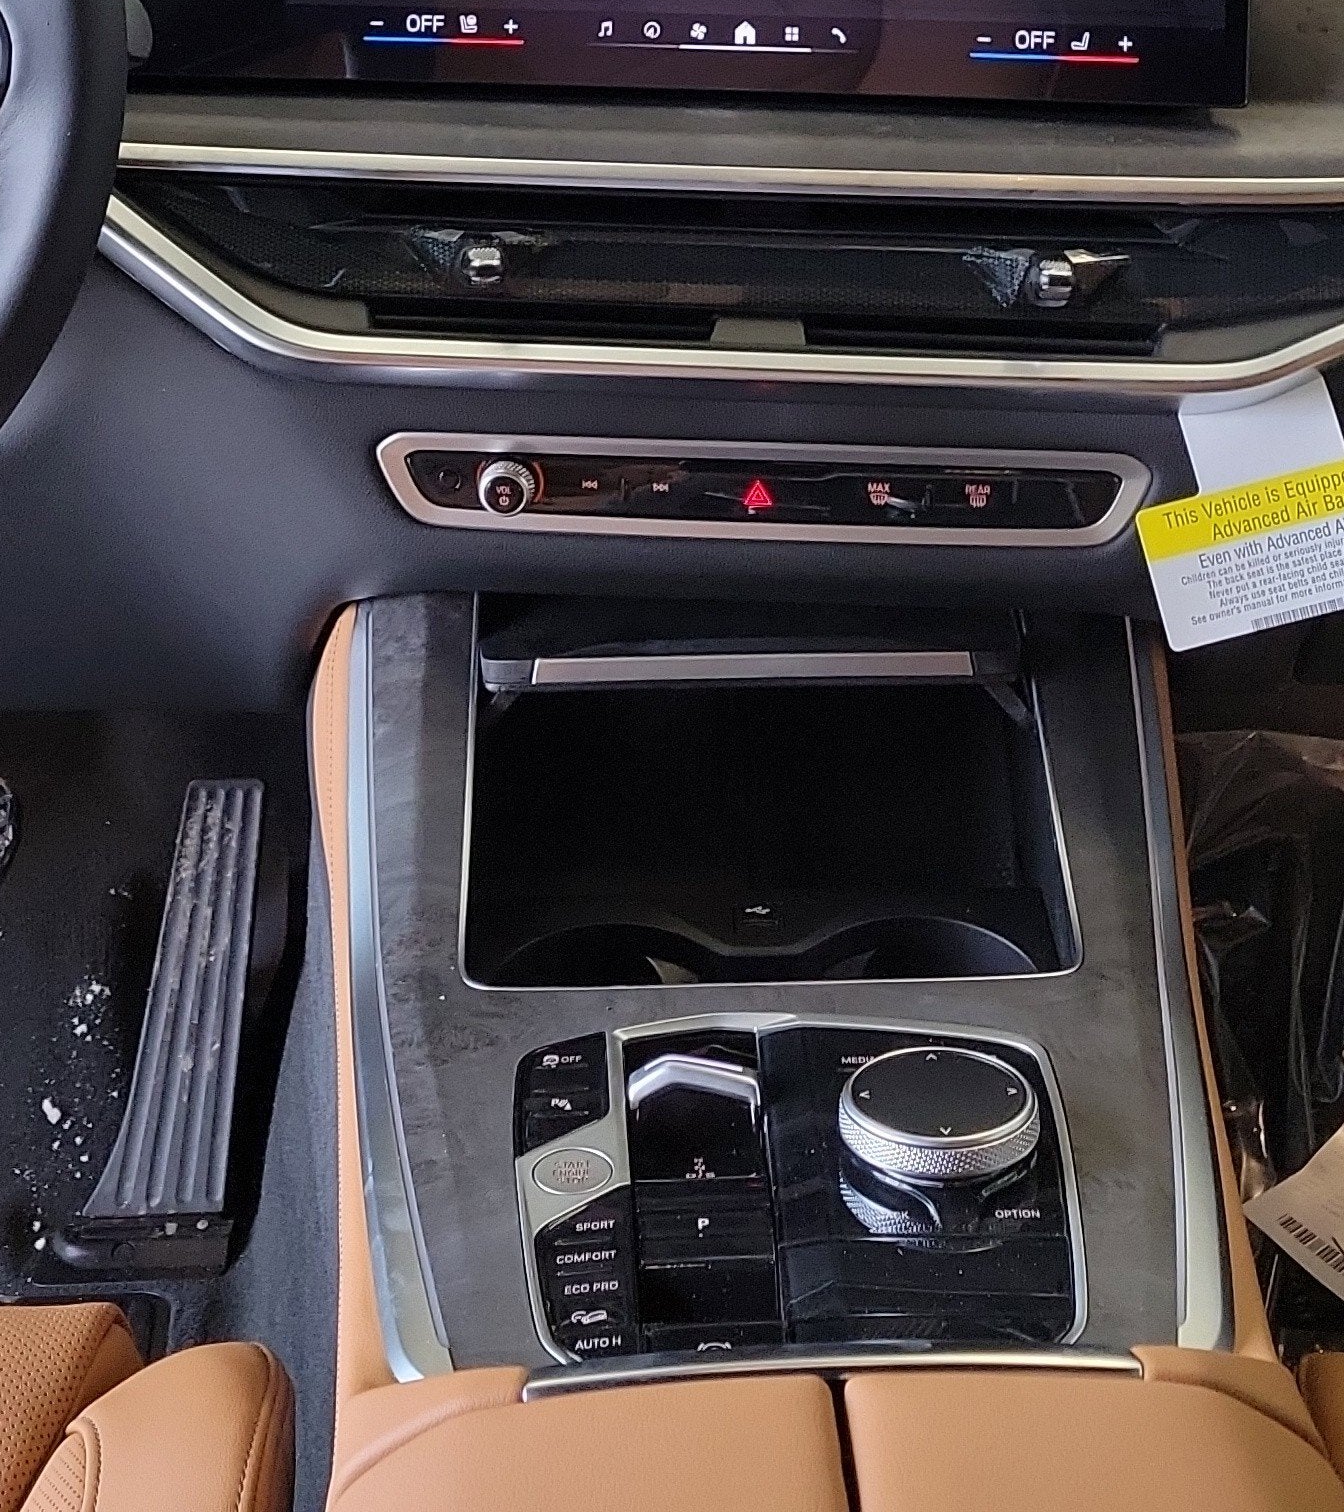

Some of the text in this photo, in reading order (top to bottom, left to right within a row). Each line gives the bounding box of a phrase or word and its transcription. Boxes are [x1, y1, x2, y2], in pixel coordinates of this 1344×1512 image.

[405, 13, 446, 33] OFF
[1014, 29, 1056, 50] OFF
[496, 485, 512, 495] VOL
[867, 482, 891, 493] MAX
[1162, 505, 1198, 529] This
[1201, 489, 1261, 520] Vehicle
[1264, 484, 1280, 503] is
[1209, 505, 1290, 540] Advanced
[1293, 497, 1319, 518] Air
[1198, 547, 1231, 568] Even
[1232, 538, 1263, 560] with
[1264, 521, 1331, 552] Advanced
[1180, 568, 1216, 585] Children
[1217, 565, 1233, 576] can
[1234, 561, 1245, 571] be
[1247, 554, 1270, 568] killed
[1272, 553, 1281, 562] or
[1283, 541, 1322, 559] seriously
[1206, 577, 1222, 589] The
[1224, 572, 1244, 584] back
[1245, 567, 1264, 579] seat
[1265, 564, 1274, 574] is
[1275, 560, 1289, 571] the
[1291, 553, 1317, 567] safest
[1318, 547, 1342, 561] place
[1208, 585, 1233, 599] Never
[1234, 581, 1250, 593] put
[1258, 567, 1304, 586] rear-facing
[1306, 561, 1327, 573] child
[1218, 592, 1249, 607] Always
[1250, 589, 1266, 599] use
[1267, 582, 1285, 594] seat
[1287, 576, 1309, 589] belts
[1310, 572, 1326, 583] and
[1190, 613, 1207, 625] See
[1208, 604, 1241, 621] owner's
[1242, 596, 1274, 612] manual
[1275, 592, 1288, 603] for
[1290, 587, 1313, 599] more
[560, 1055, 582, 1064] OFF
[841, 1055, 875, 1064] MEDI
[995, 1209, 1041, 1219] OPTION
[575, 1219, 616, 1232] SPORT
[697, 1217, 710, 1230] P
[556, 1250, 617, 1265] COMFORT
[564, 1280, 619, 1295] ECO PRO
[575, 1334, 622, 1351] AUTO H
